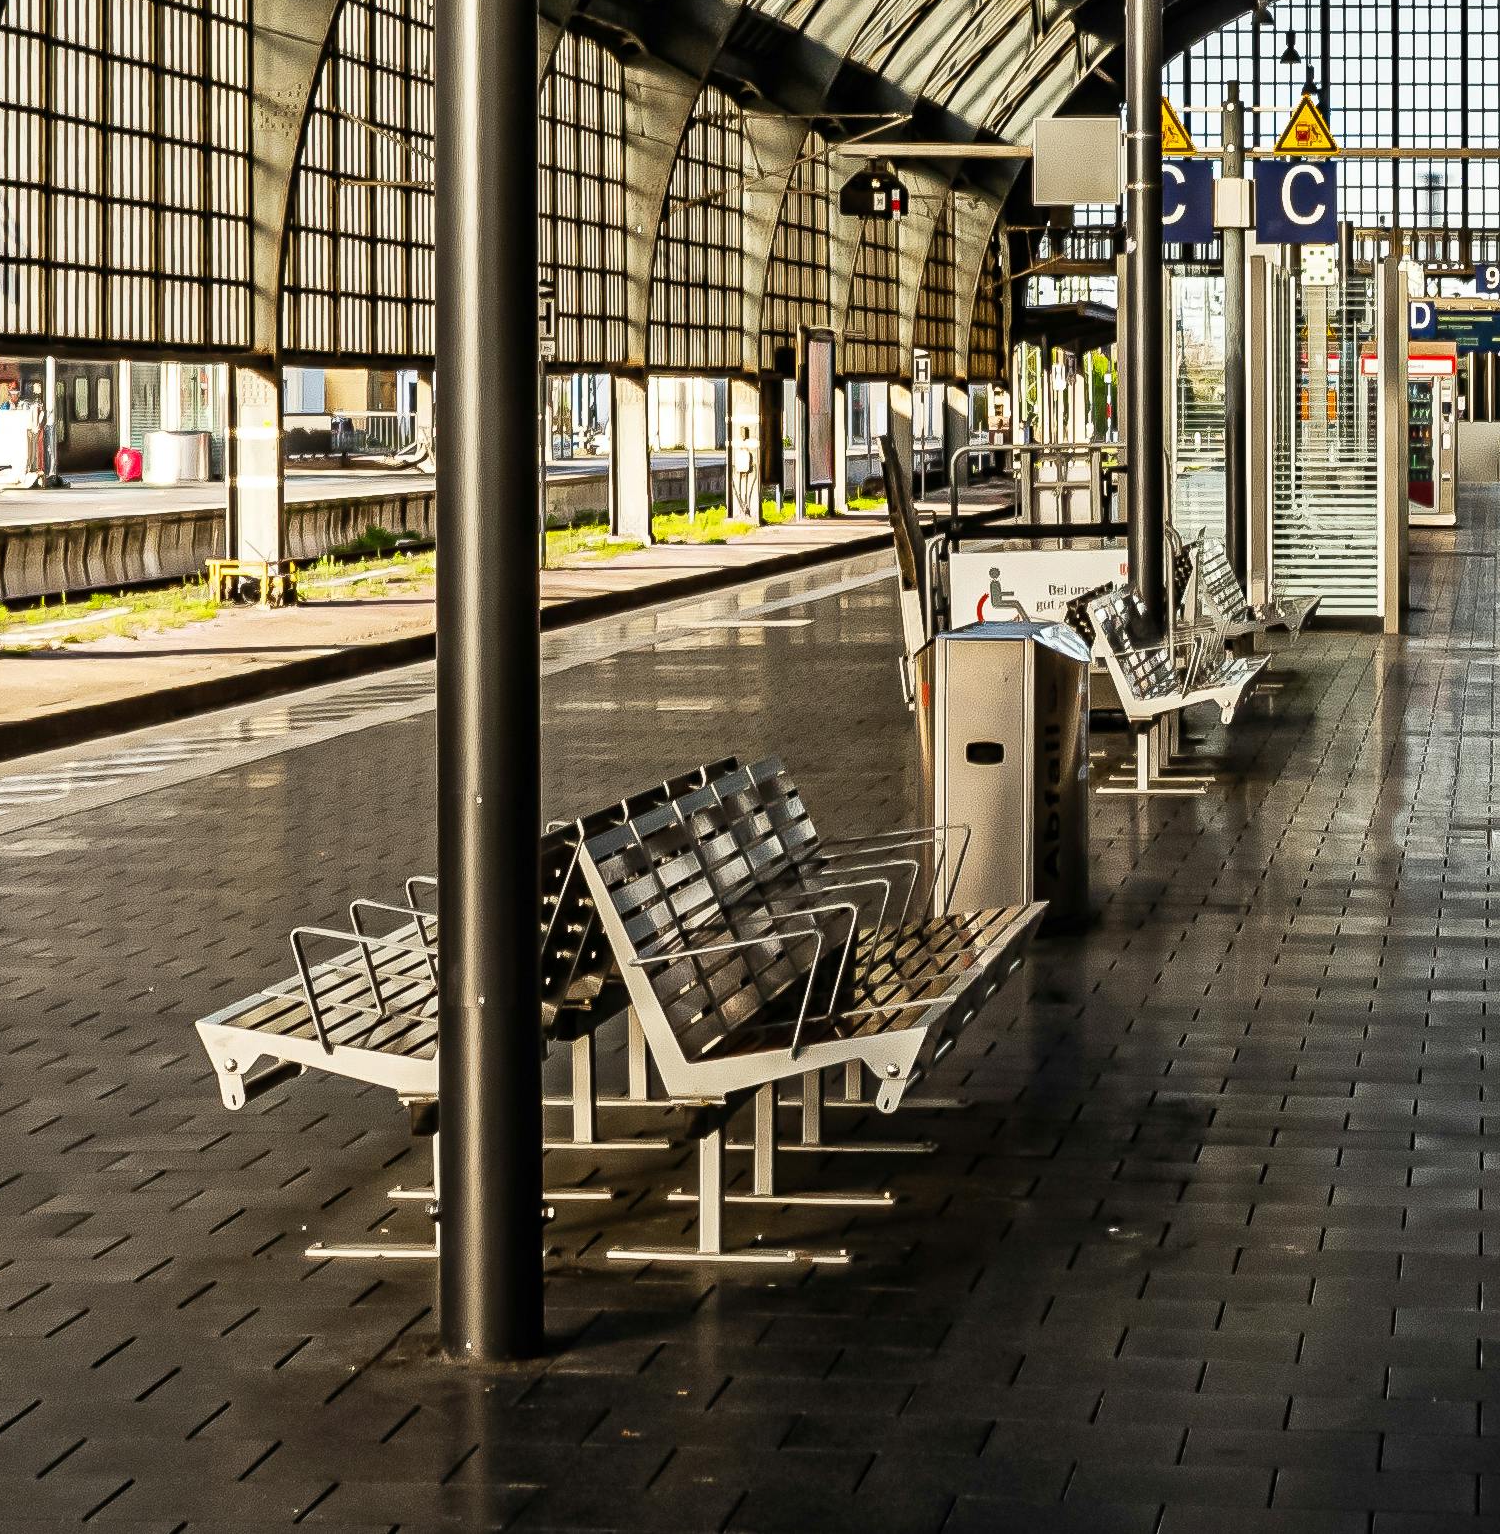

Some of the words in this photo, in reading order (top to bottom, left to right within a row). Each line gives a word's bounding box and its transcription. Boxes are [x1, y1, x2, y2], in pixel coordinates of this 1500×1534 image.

[1281, 164, 1326, 225] C
[1485, 266, 1500, 289] 9
[1410, 302, 1431, 329] D
[915, 360, 929, 381] H
[1043, 723, 1061, 882] Abfall
